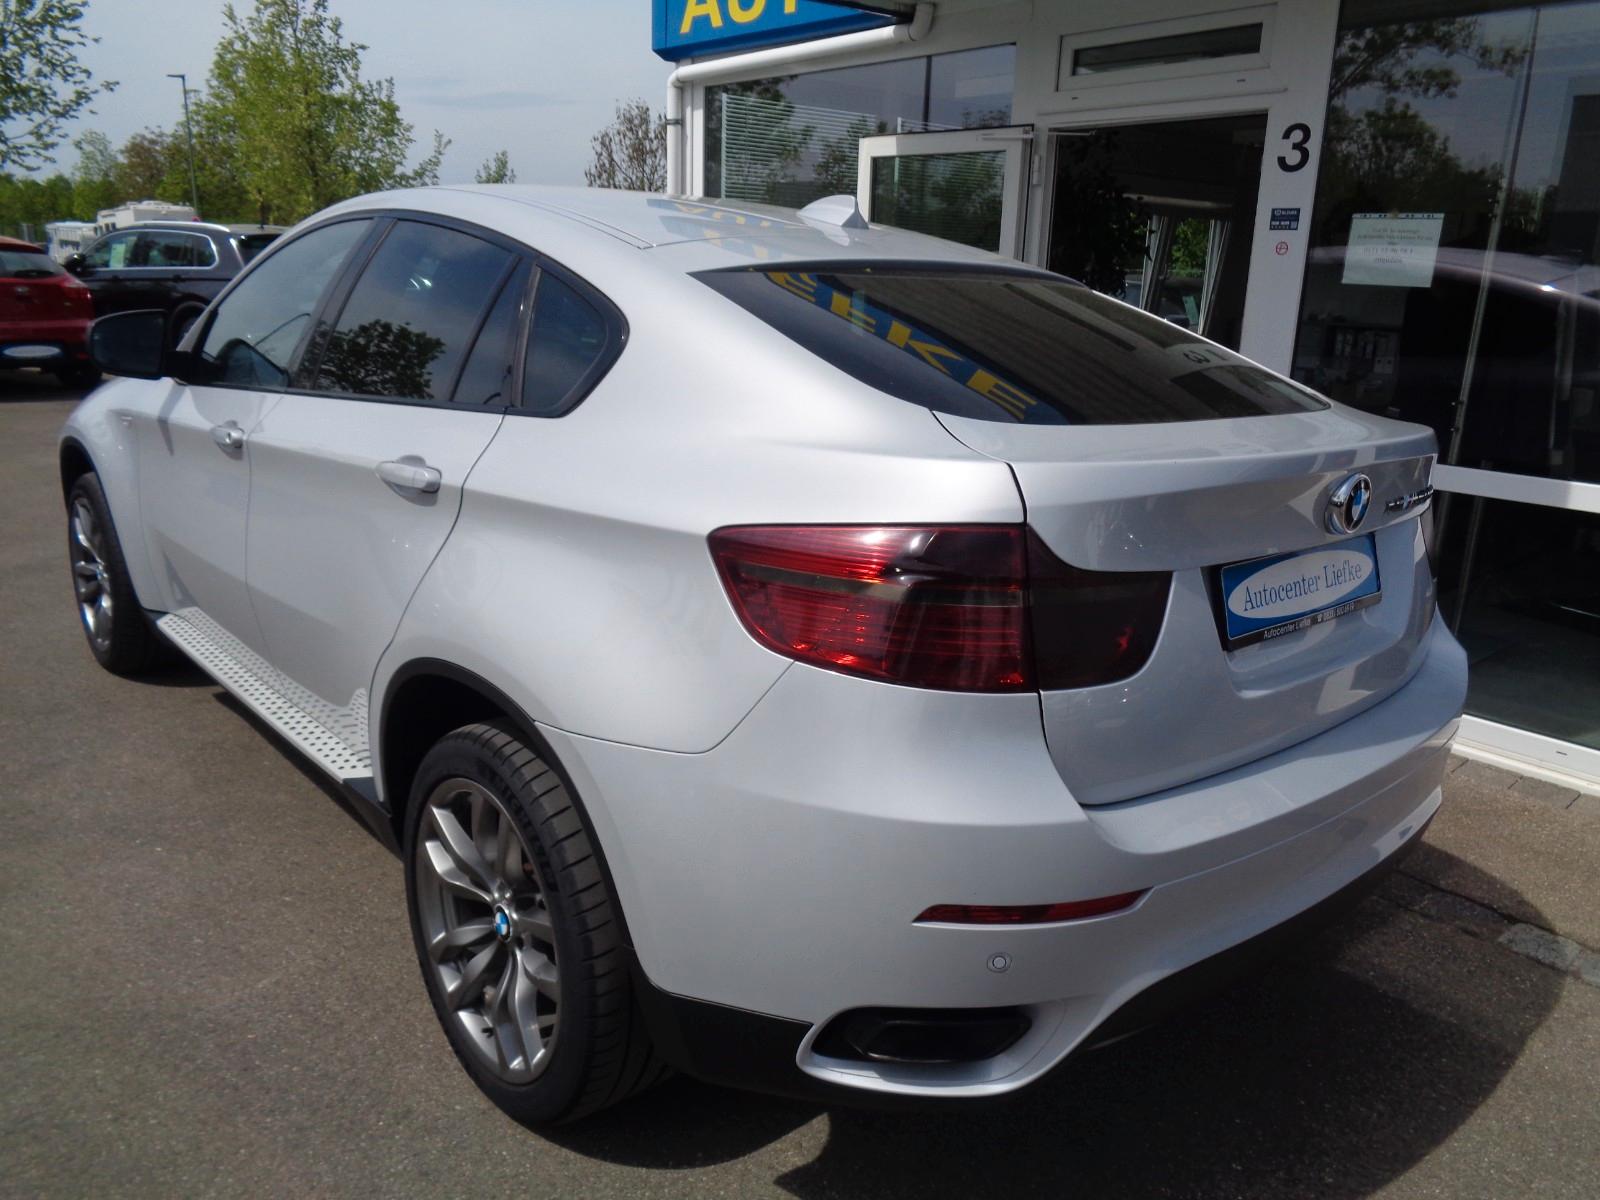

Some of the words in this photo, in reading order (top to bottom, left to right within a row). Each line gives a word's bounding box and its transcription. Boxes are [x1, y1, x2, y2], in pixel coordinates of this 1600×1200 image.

[680, 0, 797, 34] AU
[1277, 122, 1312, 173] 3
[1243, 574, 1321, 612] Autocenter
[1323, 560, 1362, 589] Liefke
[1263, 622, 1296, 640] Autocenter
